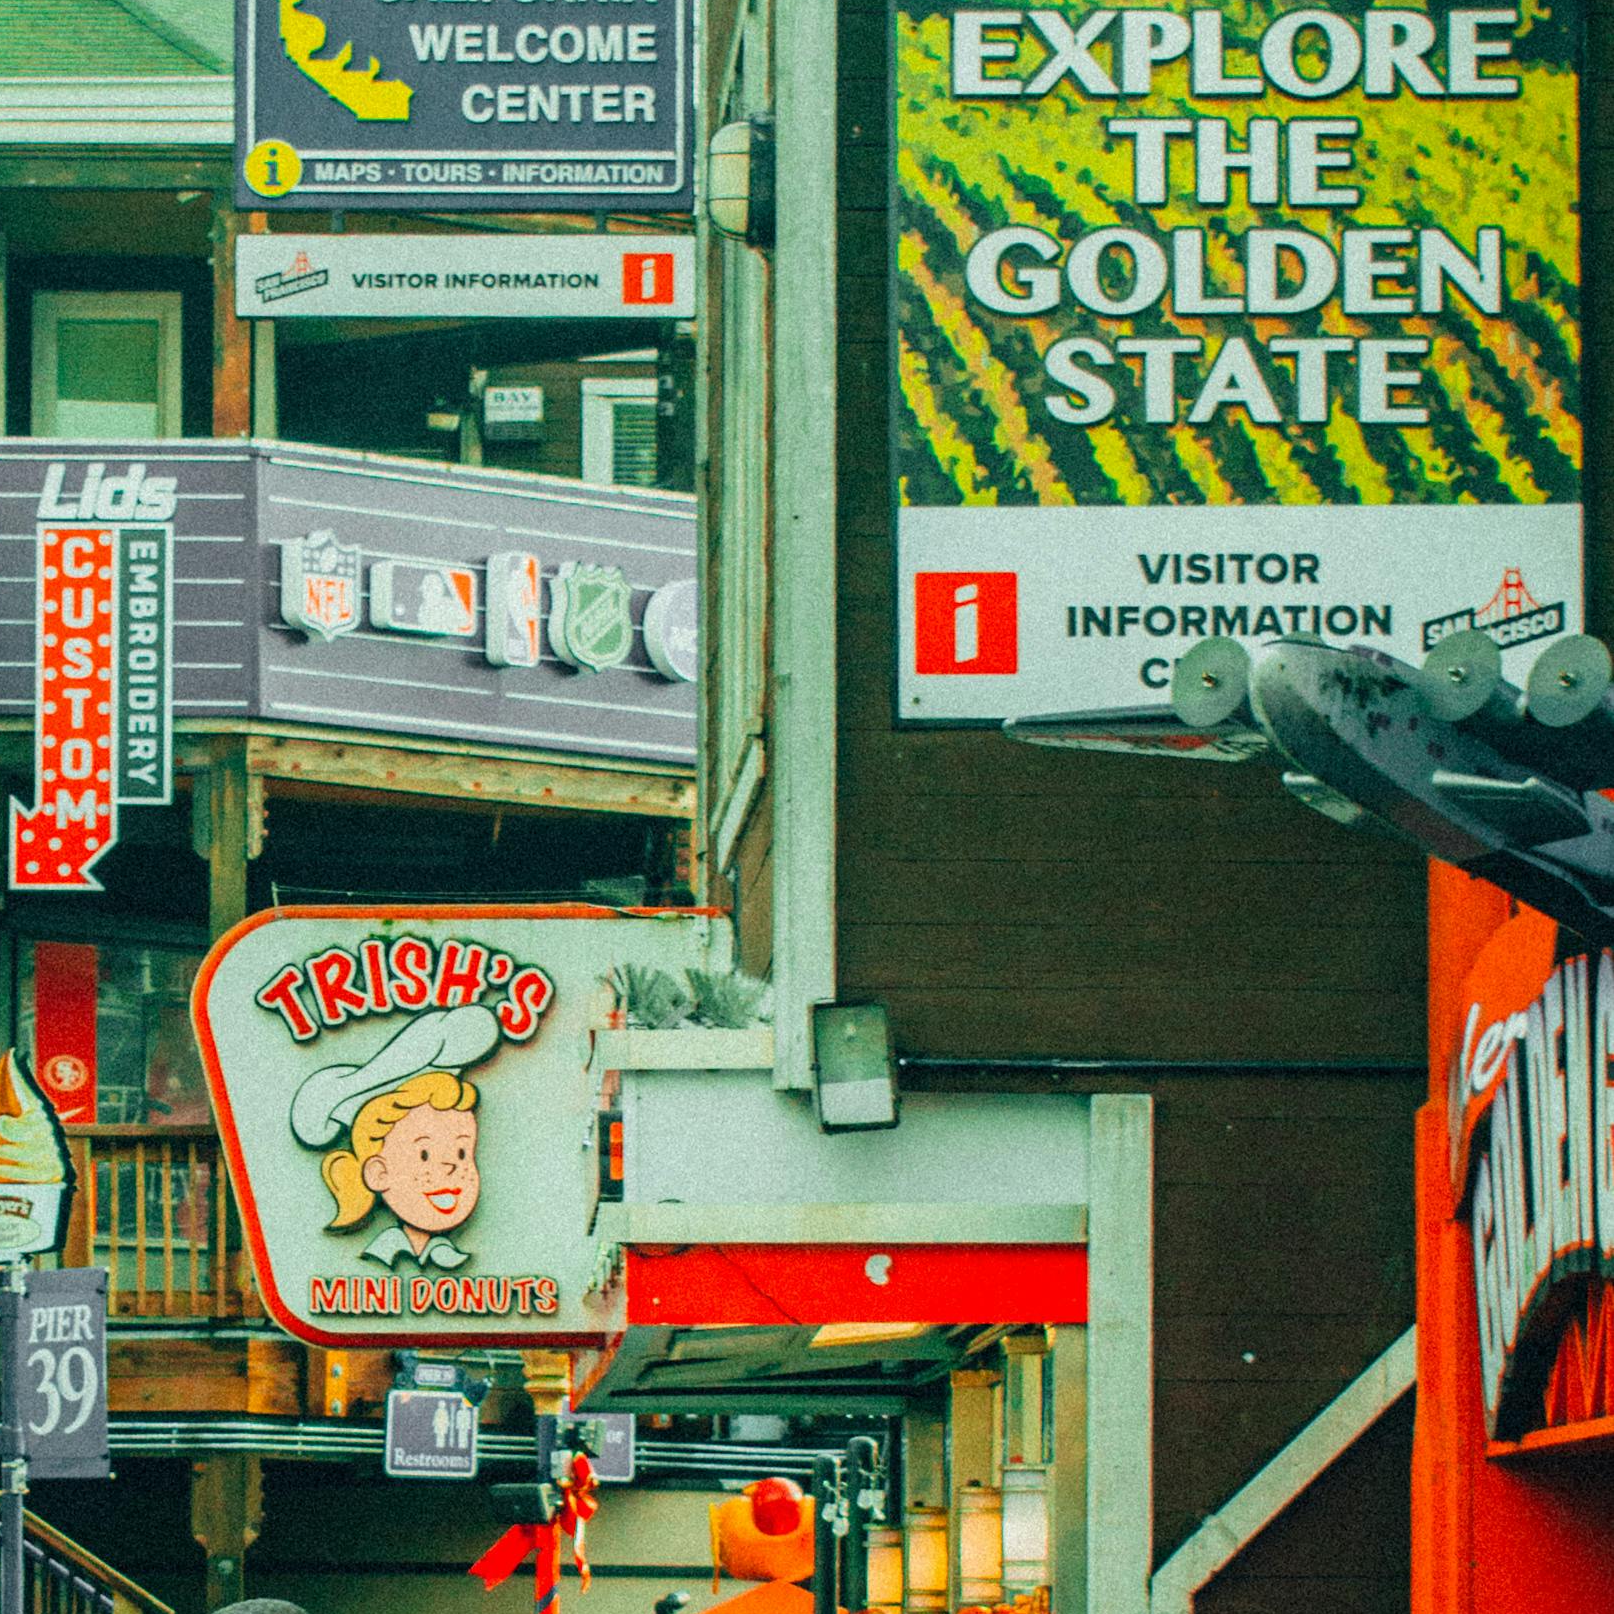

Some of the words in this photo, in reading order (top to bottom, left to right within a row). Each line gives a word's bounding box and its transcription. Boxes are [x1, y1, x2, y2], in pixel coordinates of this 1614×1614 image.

[408, 24, 658, 63] WELCOME
[950, 8, 1520, 99] EXPLORE
[461, 84, 657, 123] CENTER
[315, 162, 381, 184] MAPS
[402, 162, 481, 184] TOURS
[502, 162, 664, 184] INFORMATION
[1108, 117, 1361, 207] THE
[352, 273, 438, 289] VISITOR
[445, 273, 599, 289] INFORMATION
[965, 225, 1502, 316] GOLDEN
[1043, 336, 1429, 427] STATE
[36, 463, 178, 520] Lids
[1137, 553, 1320, 584] VISITOR
[306, 576, 351, 623] NFL
[1066, 604, 1393, 637] INFORMATION
[55, 537, 97, 830] CUSTOM
[128, 541, 159, 785] EMBROIDERY
[258, 937, 554, 1041] TRISH'S
[310, 1276, 400, 1314] MINI
[410, 1276, 559, 1314] DONUTS
[29, 1304, 94, 1343] PIER
[27, 1346, 98, 1435] 39
[394, 1447, 471, 1469] Restrooms
